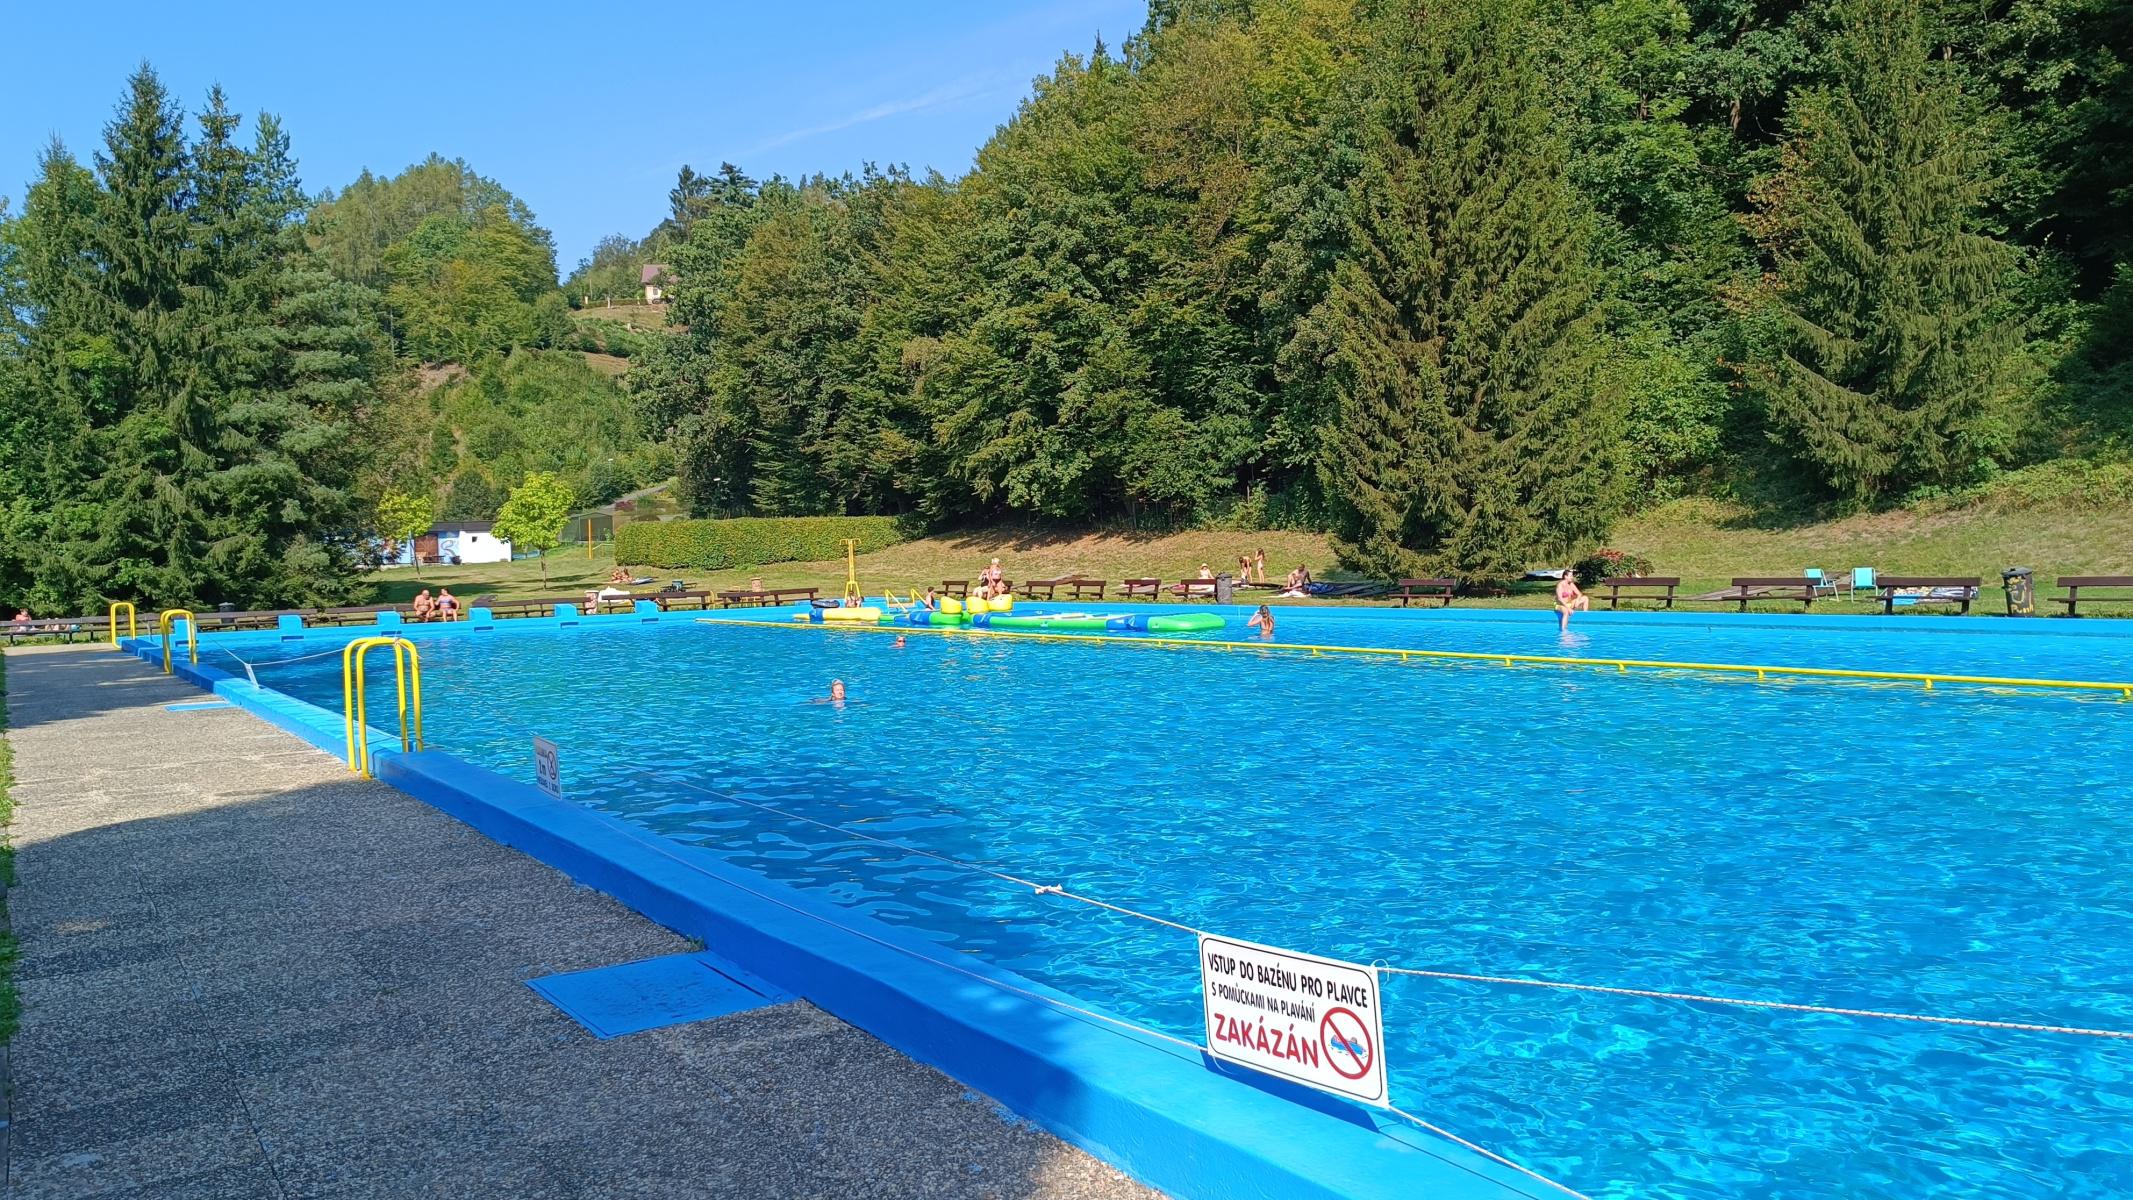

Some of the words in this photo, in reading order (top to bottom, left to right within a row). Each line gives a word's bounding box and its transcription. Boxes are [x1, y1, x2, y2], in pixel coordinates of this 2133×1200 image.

[1207, 952, 1236, 976] VSTUP
[1240, 960, 1254, 981] DO
[1257, 962, 1297, 992] BAZÉNU
[1301, 974, 1323, 998] PRO
[1327, 980, 1368, 1009] PLAVCE
[1211, 981, 1217, 997] S
[1267, 996, 1280, 1014] NA
[1281, 999, 1316, 1023] PLAVÁNÍ
[1214, 1012, 1319, 1069] ZAKÁZÁN
